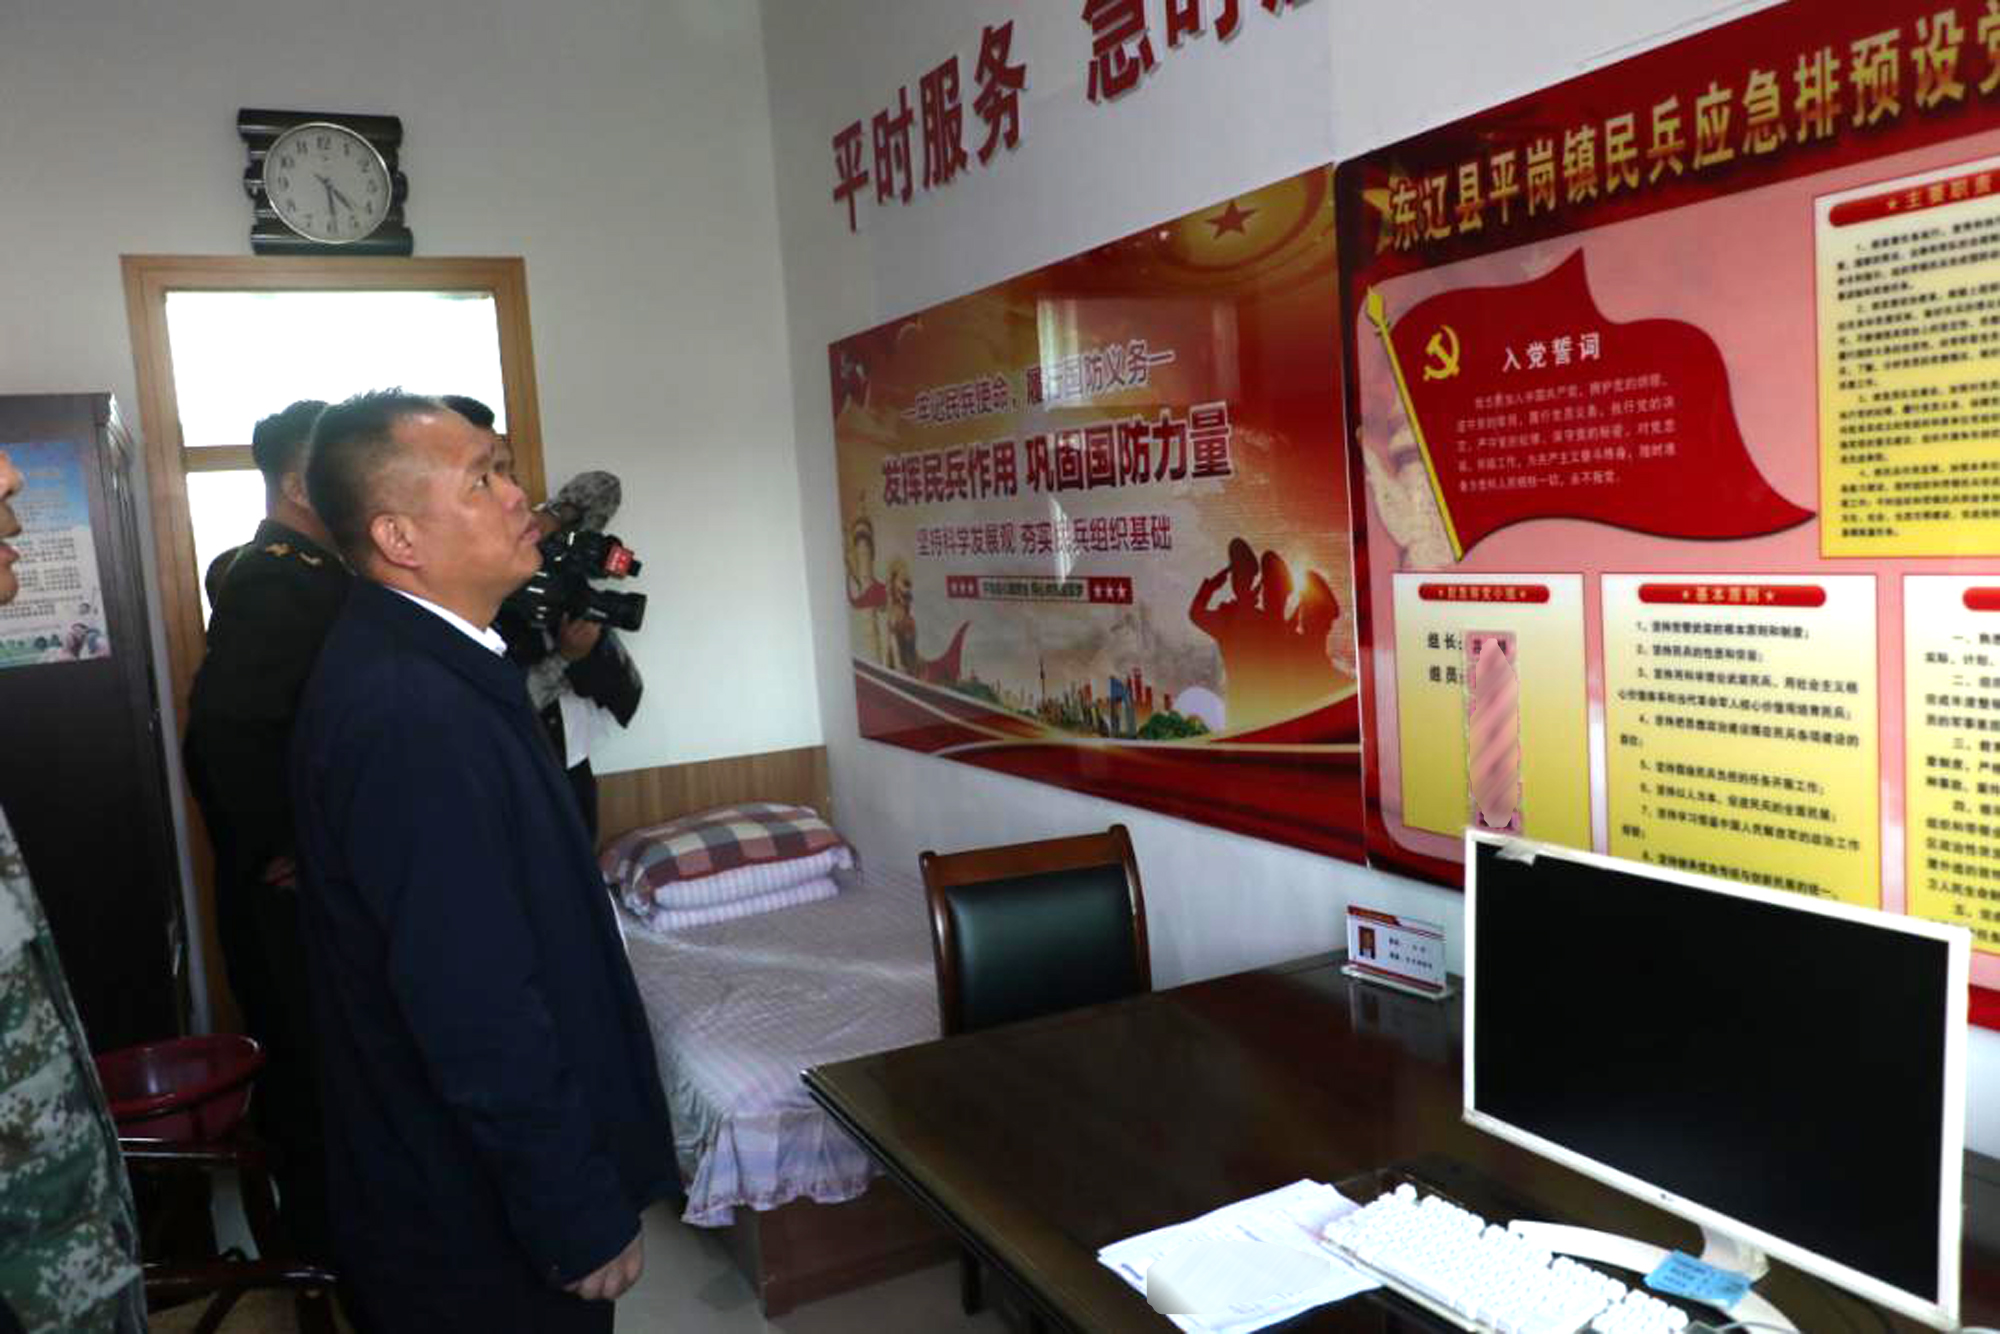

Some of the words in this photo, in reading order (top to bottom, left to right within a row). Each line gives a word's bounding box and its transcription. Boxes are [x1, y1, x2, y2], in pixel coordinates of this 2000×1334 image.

[832, 20, 1028, 233] 平时服务
[1502, 332, 1601, 373] 入党誓词
[882, 440, 1018, 508] 发挥民兵作用
[1026, 402, 1232, 494] 巩固国防力量
